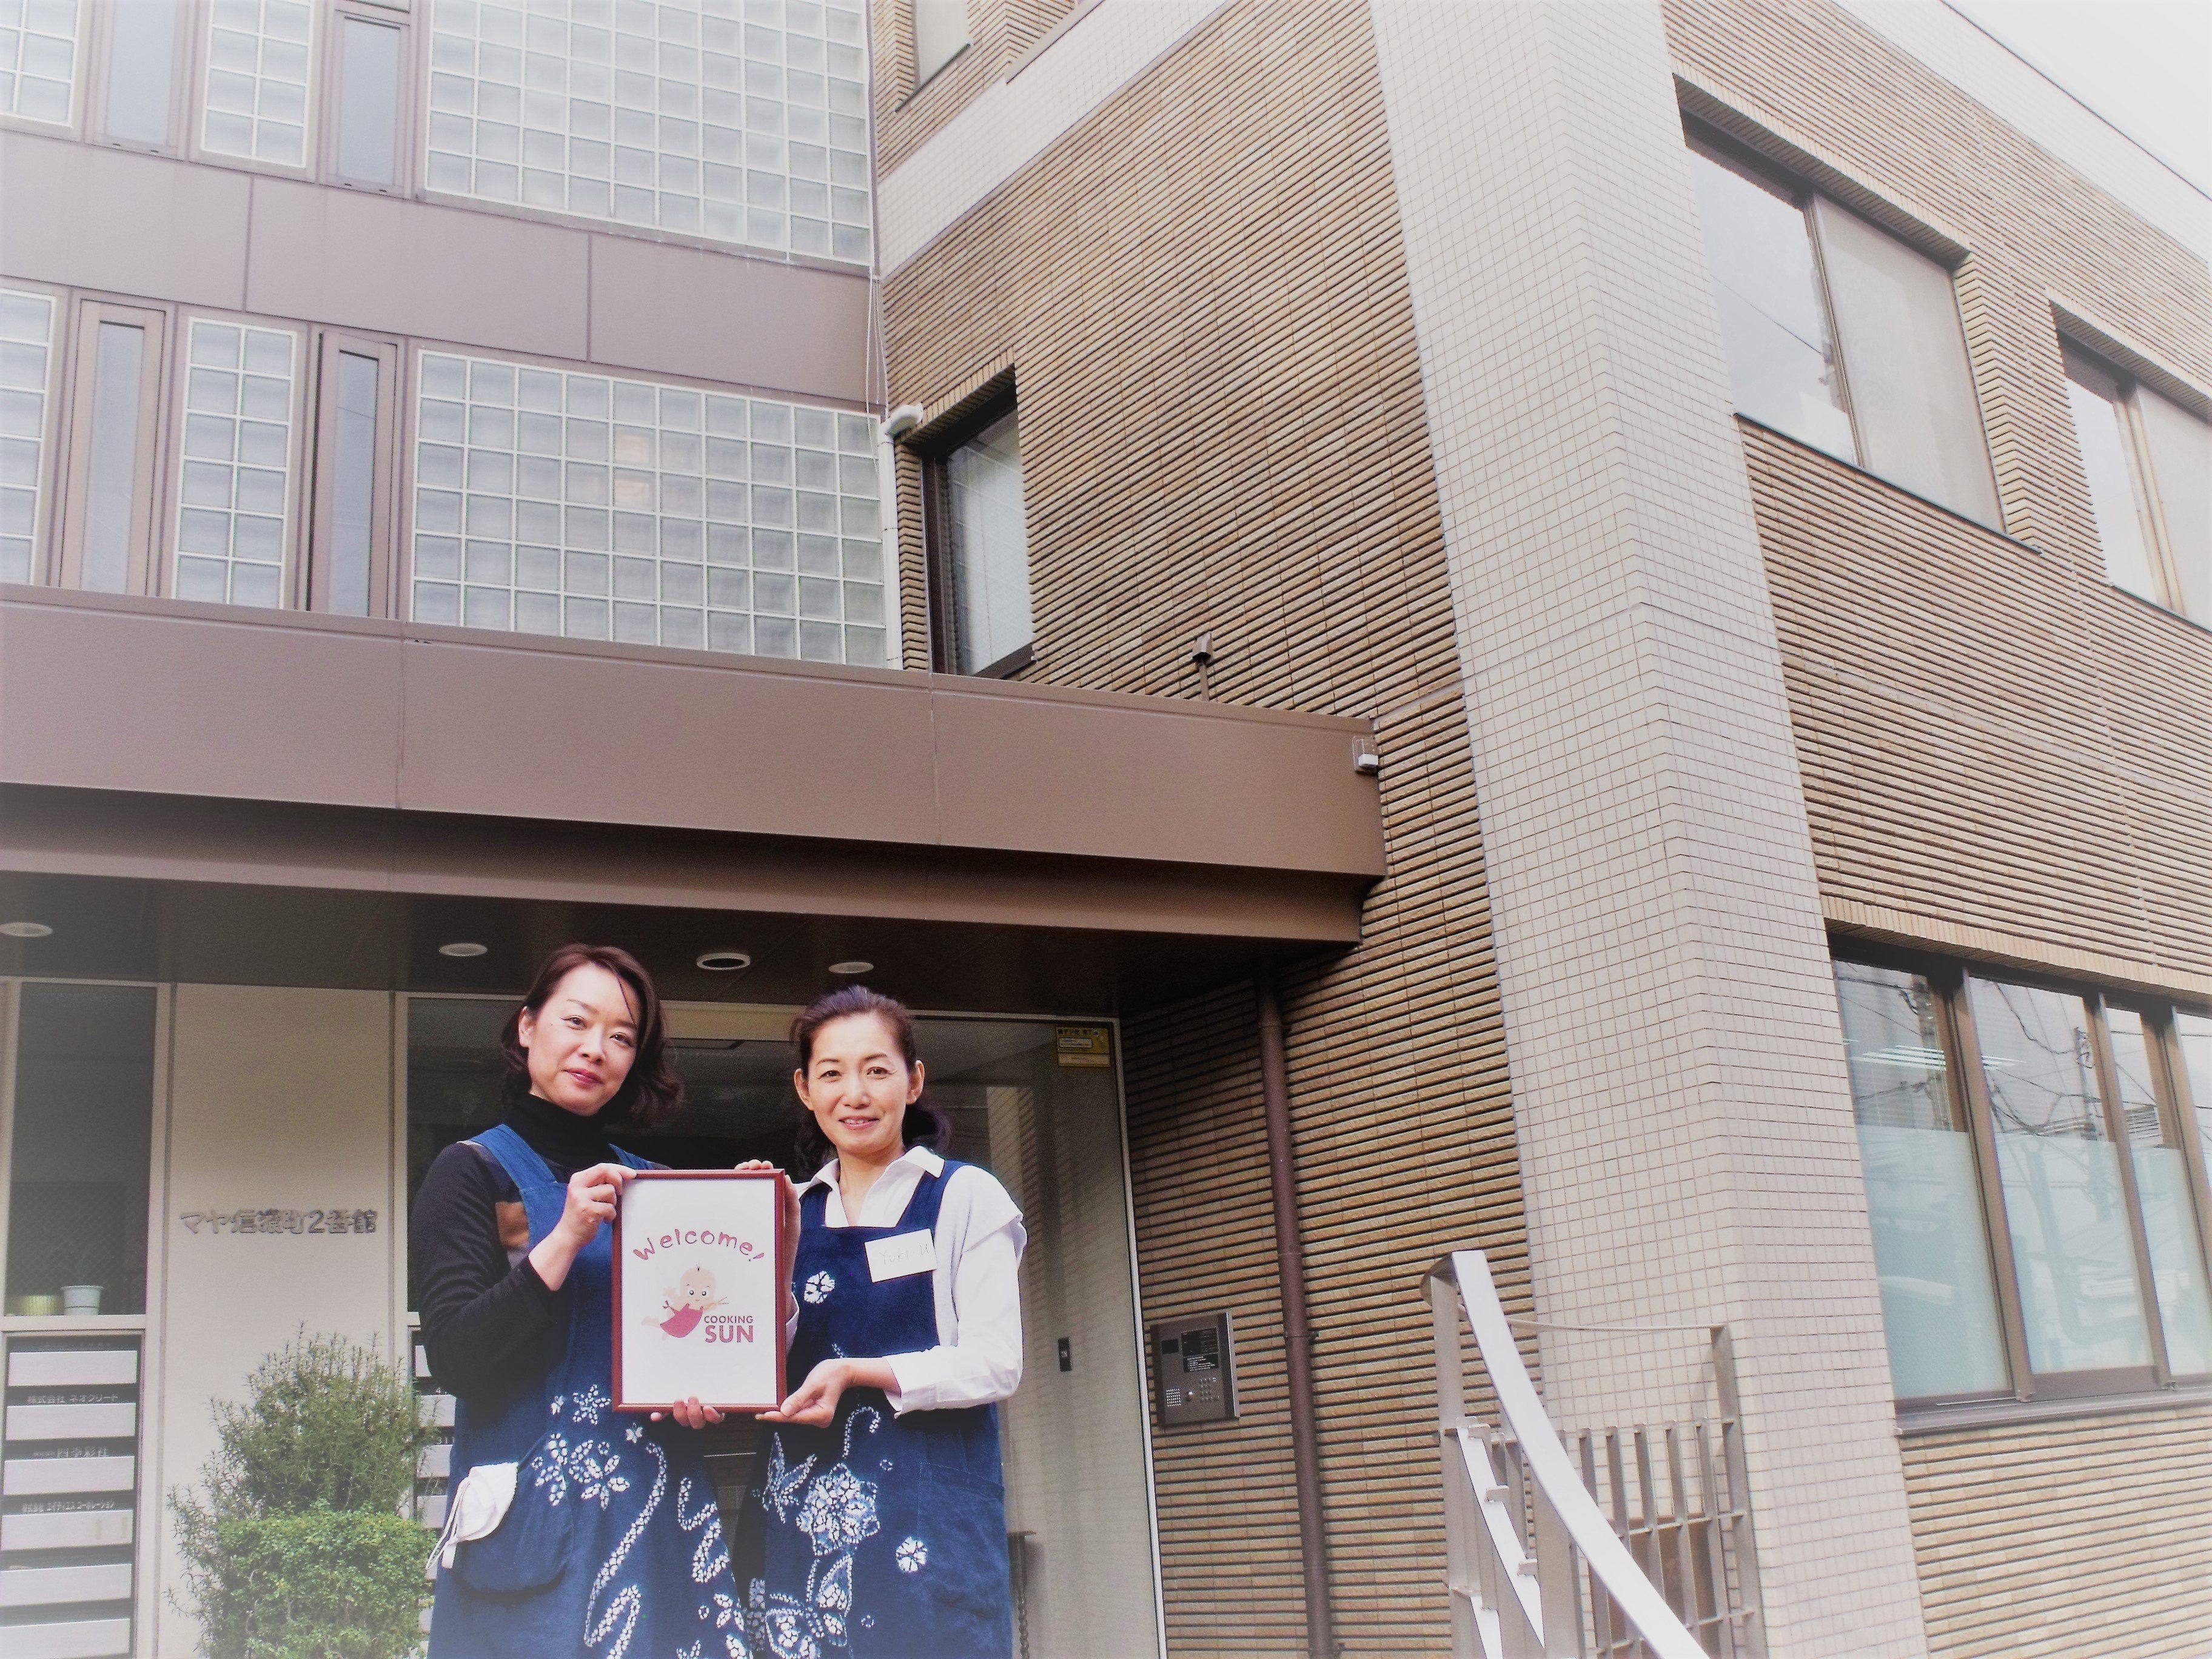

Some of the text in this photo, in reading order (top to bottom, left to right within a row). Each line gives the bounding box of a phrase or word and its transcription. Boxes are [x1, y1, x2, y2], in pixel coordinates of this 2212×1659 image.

[633, 1228, 765, 1262] Welcome!
[704, 1315, 754, 1324] COOKING
[705, 1326, 754, 1343] SUN
